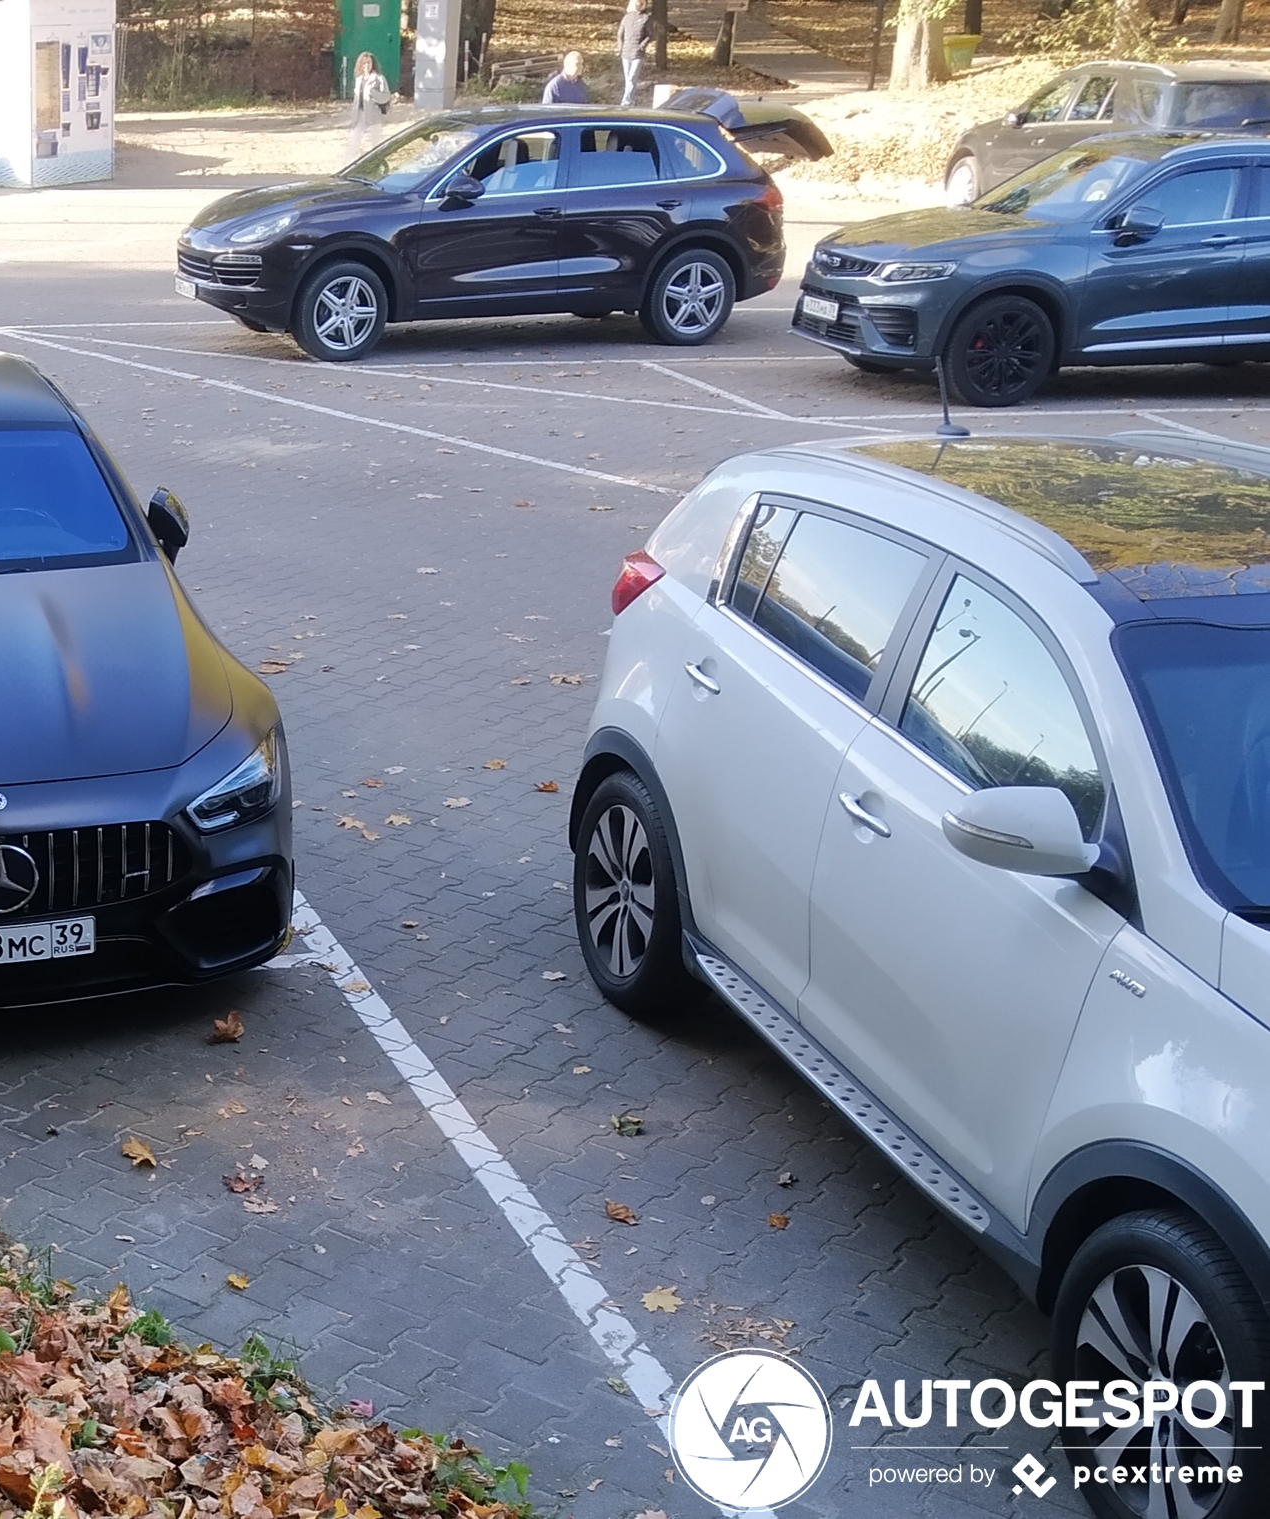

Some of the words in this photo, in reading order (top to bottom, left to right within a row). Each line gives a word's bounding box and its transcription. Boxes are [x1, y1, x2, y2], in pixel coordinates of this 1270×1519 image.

[55, 923, 84, 945] 39
[54, 945, 75, 954] RUS
[1109, 969, 1146, 998] AWD
